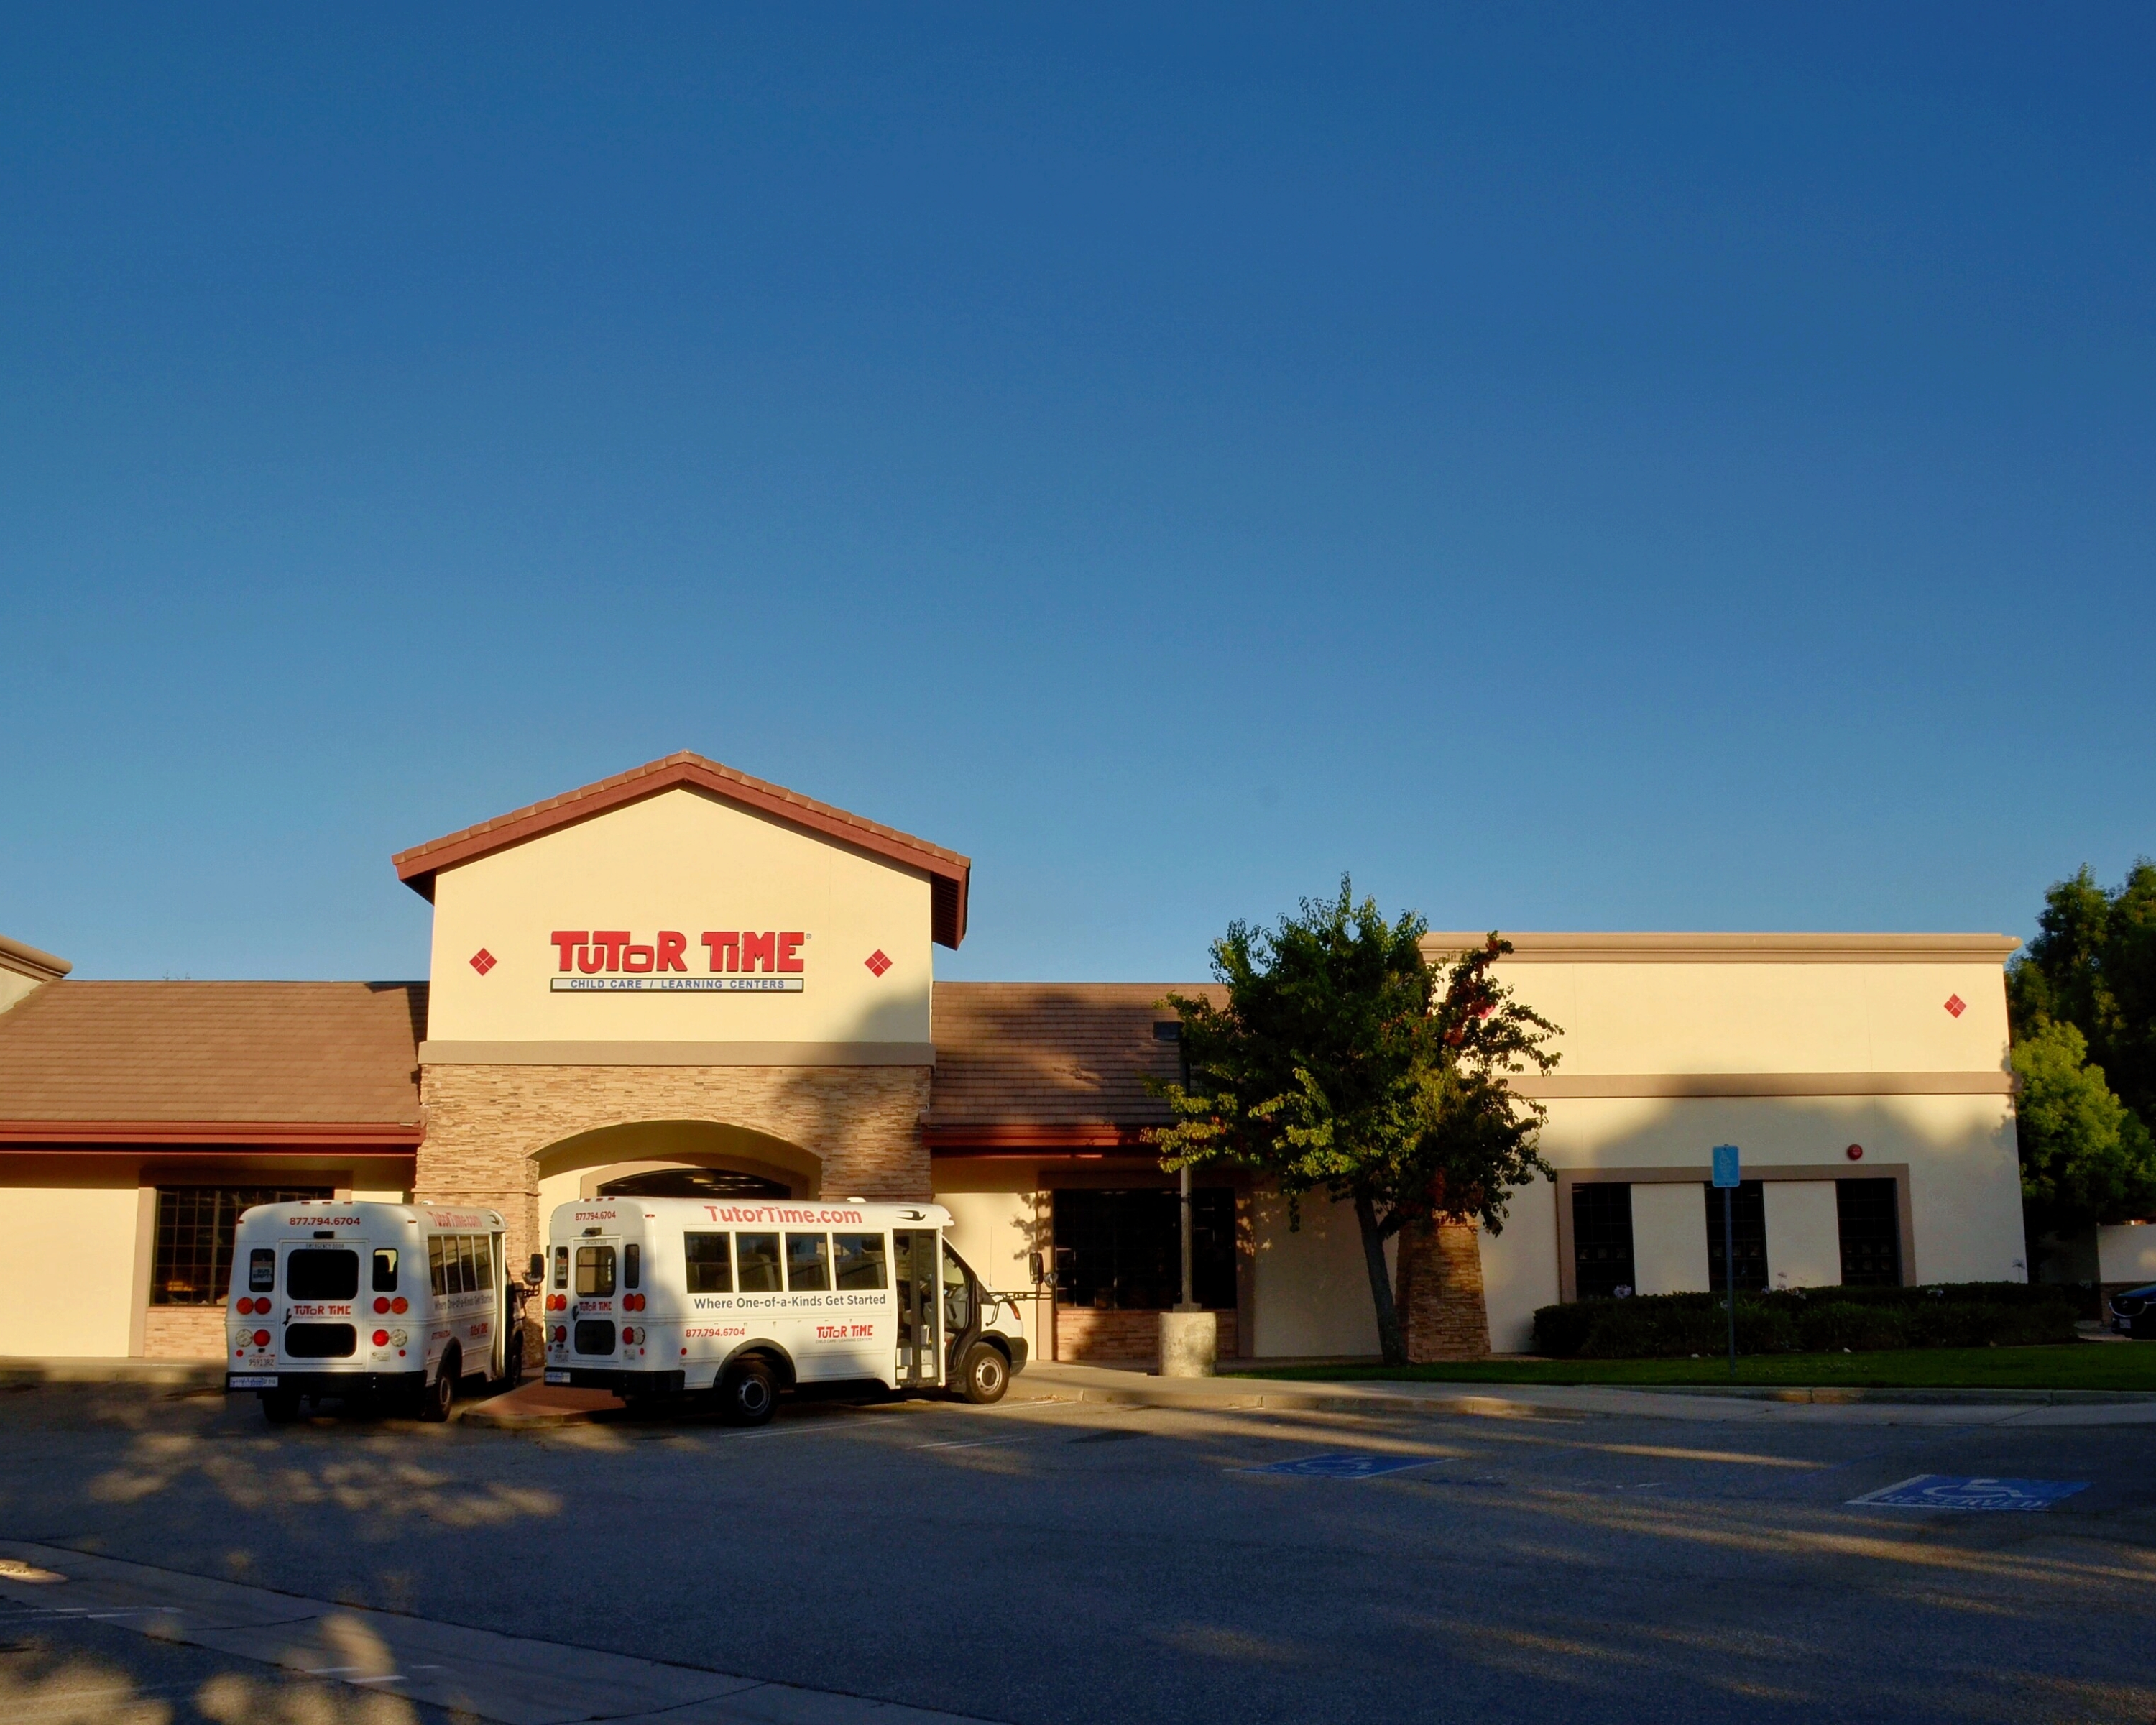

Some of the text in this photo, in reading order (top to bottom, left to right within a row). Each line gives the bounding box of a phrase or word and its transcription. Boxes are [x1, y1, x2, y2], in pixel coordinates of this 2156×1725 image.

[551, 931, 804, 974] TUTOR TIME
[571, 980, 605, 989] CHILD
[610, 980, 642, 989] CARE
[661, 980, 722, 989] LEARNING
[729, 980, 785, 989] CENTERS
[575, 1211, 616, 1220] 877.794.6704
[704, 1205, 862, 1223] TutorTime.com
[289, 1217, 361, 1225] 877.794.6704
[694, 1294, 886, 1309] Where One-of-a-Kinds Get Started
[686, 1328, 745, 1338] 877.794.6704
[816, 1325, 873, 1338] TUTOR TIME
